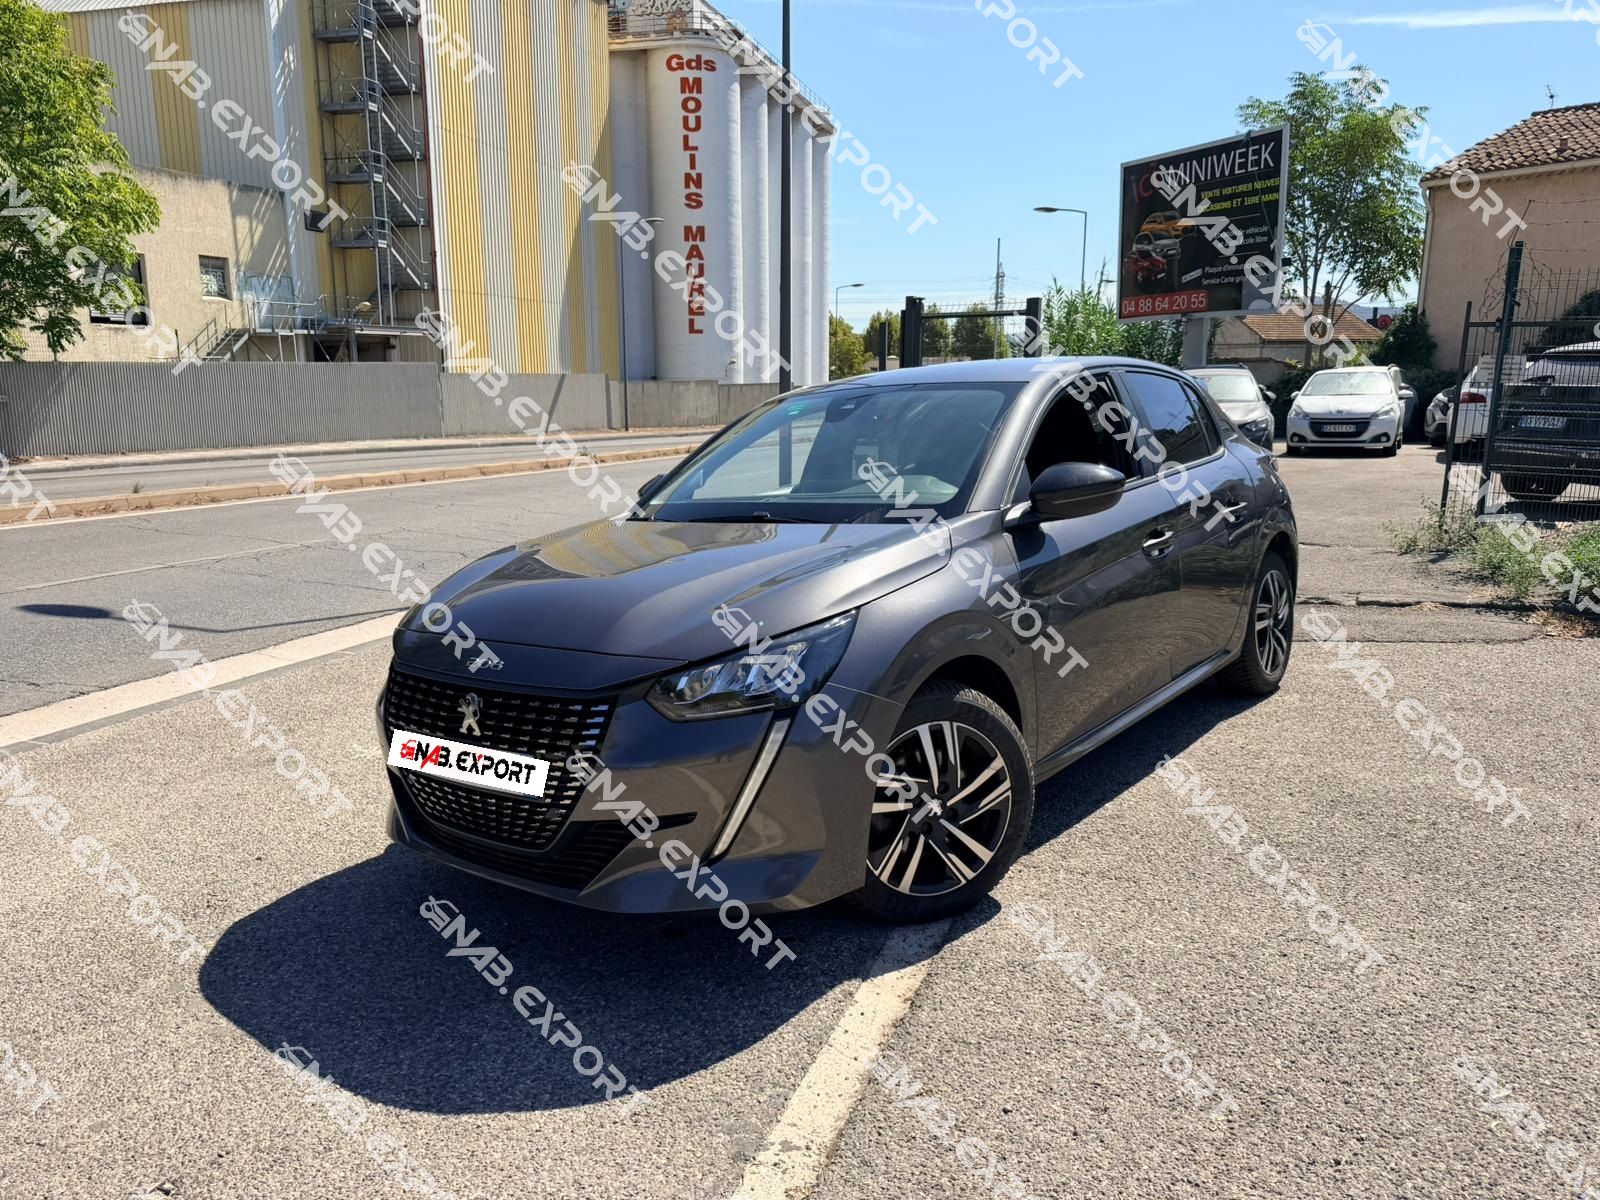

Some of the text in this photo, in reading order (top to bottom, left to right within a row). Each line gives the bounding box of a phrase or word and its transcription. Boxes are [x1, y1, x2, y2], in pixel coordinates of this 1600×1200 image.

[666, 54, 717, 72] Gds
[1201, 177, 1280, 199] VENTE VOITURES NEUVES
[679, 77, 705, 334] MOULINS MAUREL
[1232, 198, 1242, 207] ET
[1244, 195, 1260, 206] 1ERE
[1261, 192, 1279, 202] MAIN
[1201, 278, 1220, 286] Service
[1221, 276, 1235, 284] Carte
[1122, 294, 1206, 314] 04 88 64 20 55
